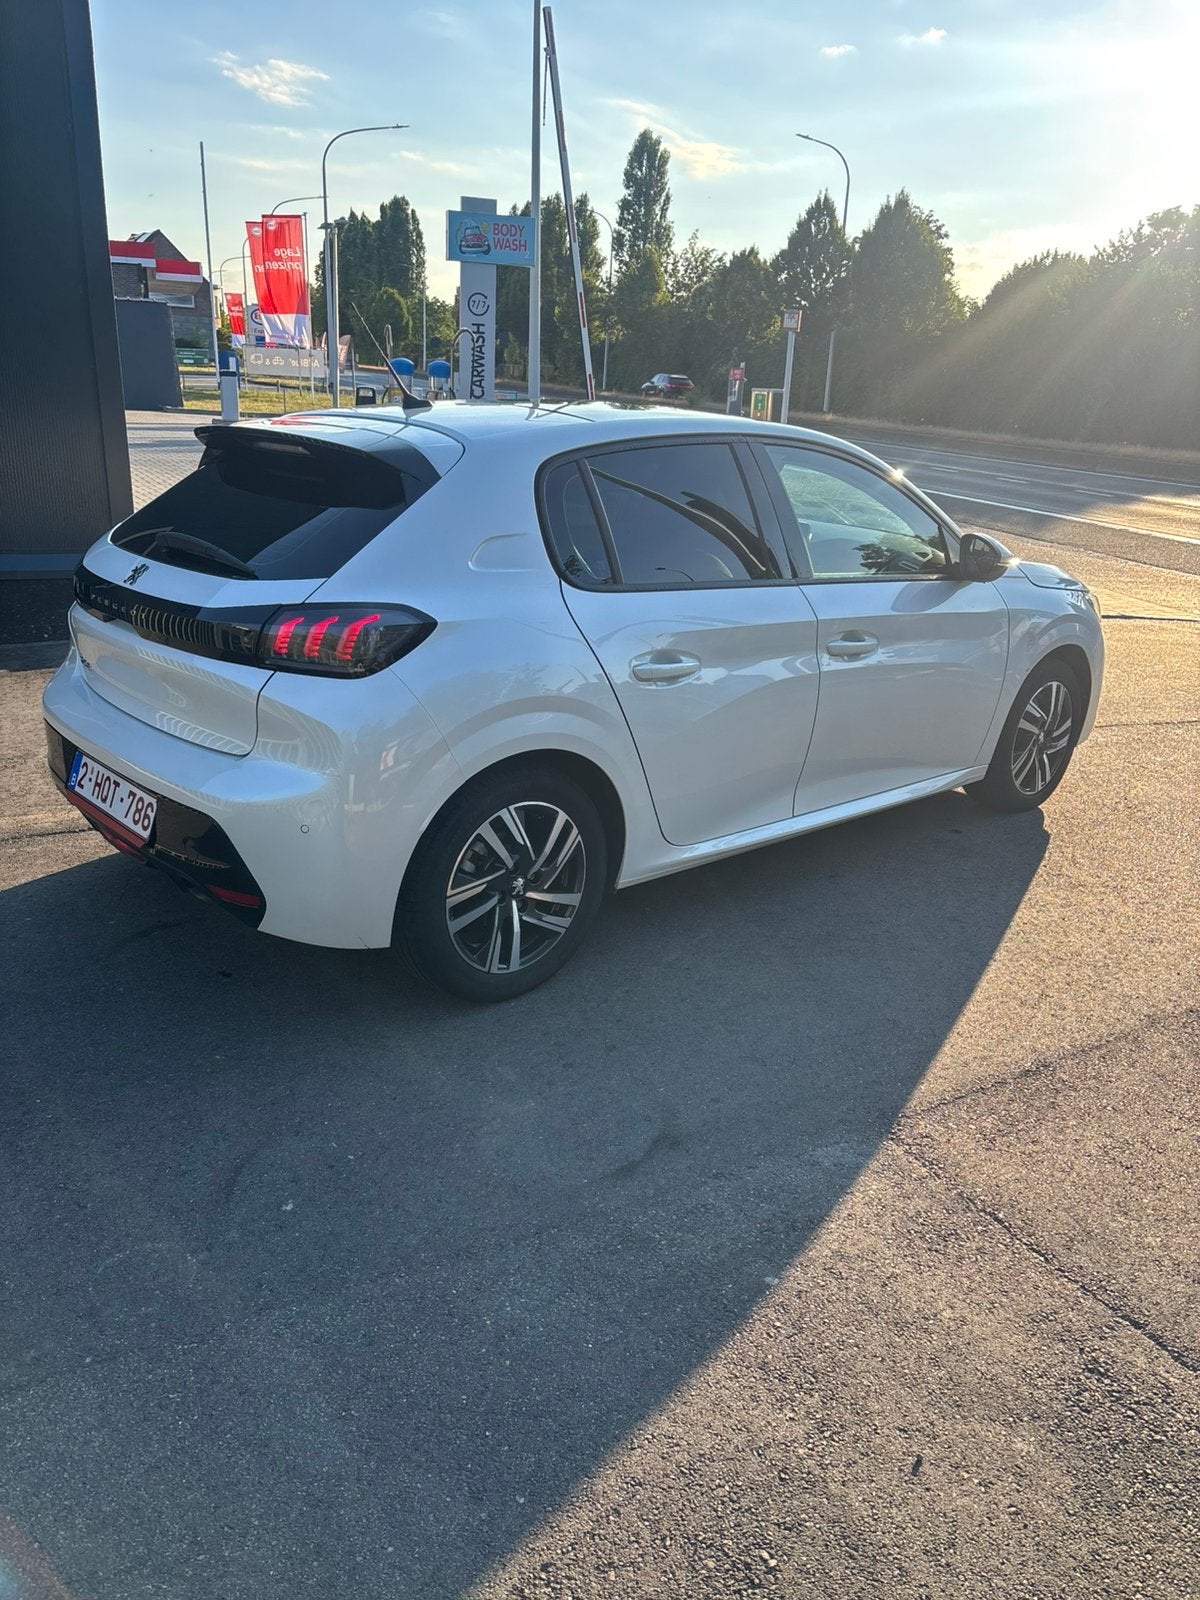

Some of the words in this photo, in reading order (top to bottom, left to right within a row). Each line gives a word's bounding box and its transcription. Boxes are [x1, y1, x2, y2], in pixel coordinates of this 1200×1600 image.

[493, 223, 525, 238] BODY
[493, 237, 527, 252] WASH
[471, 300, 487, 309] 7/7
[471, 323, 486, 399] CARWASH
